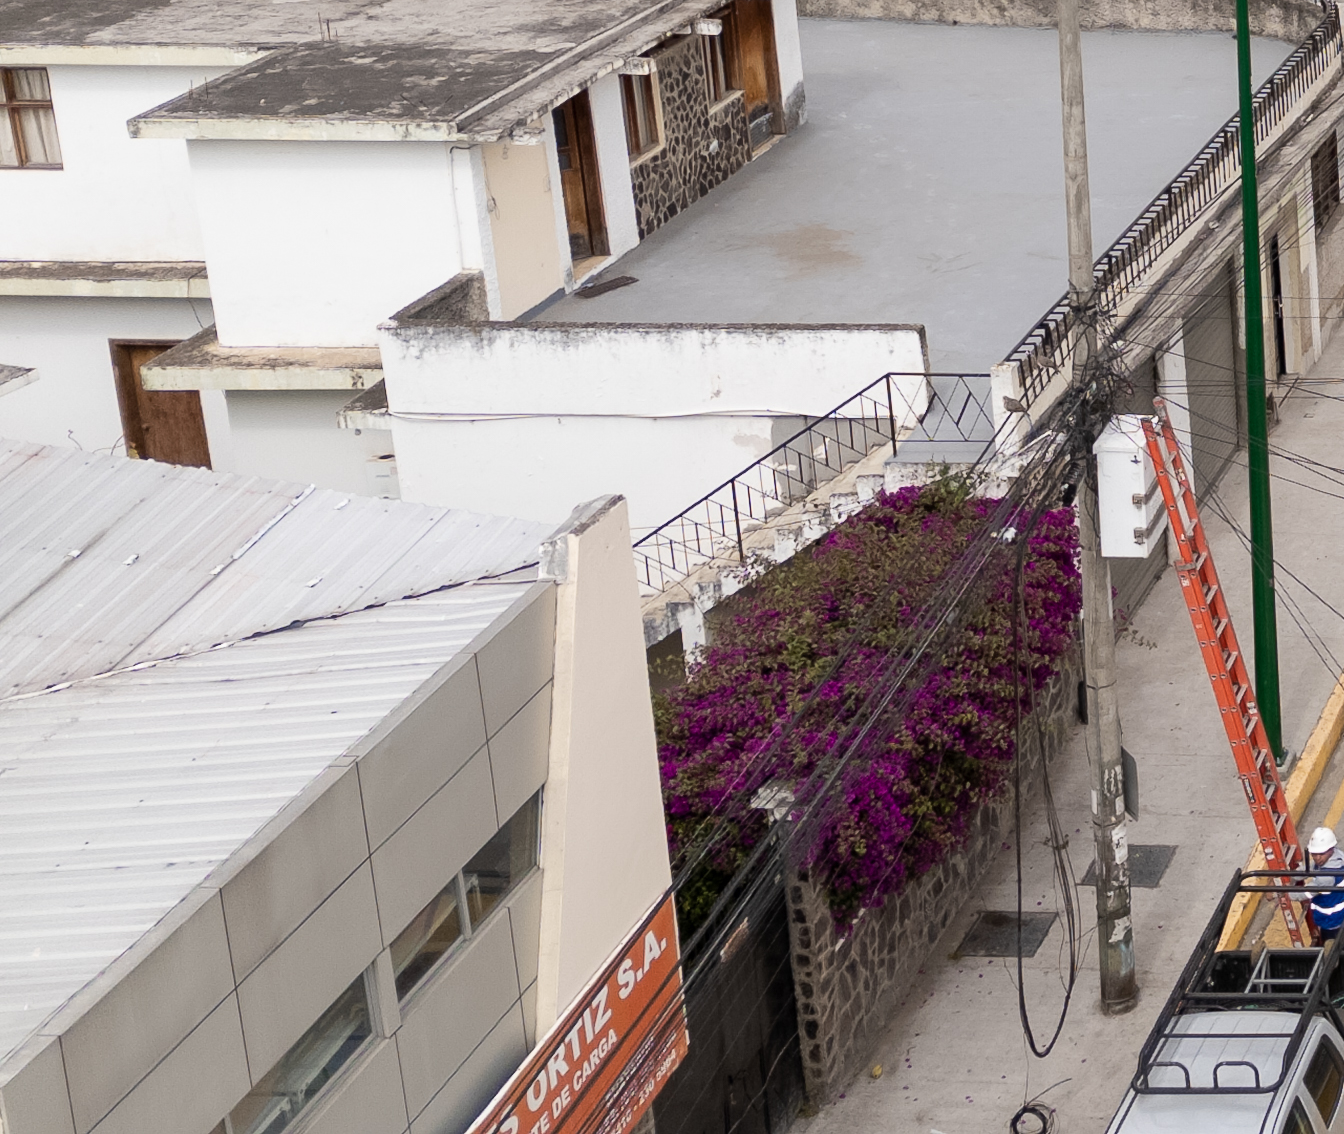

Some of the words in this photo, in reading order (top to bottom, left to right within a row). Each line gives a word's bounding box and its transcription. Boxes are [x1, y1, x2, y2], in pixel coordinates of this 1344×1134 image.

[526, 984, 613, 1113] ORTIZ
[616, 930, 667, 1000] S.A.
[551, 1084, 571, 1120] DE
[572, 1028, 618, 1092] CARGA
